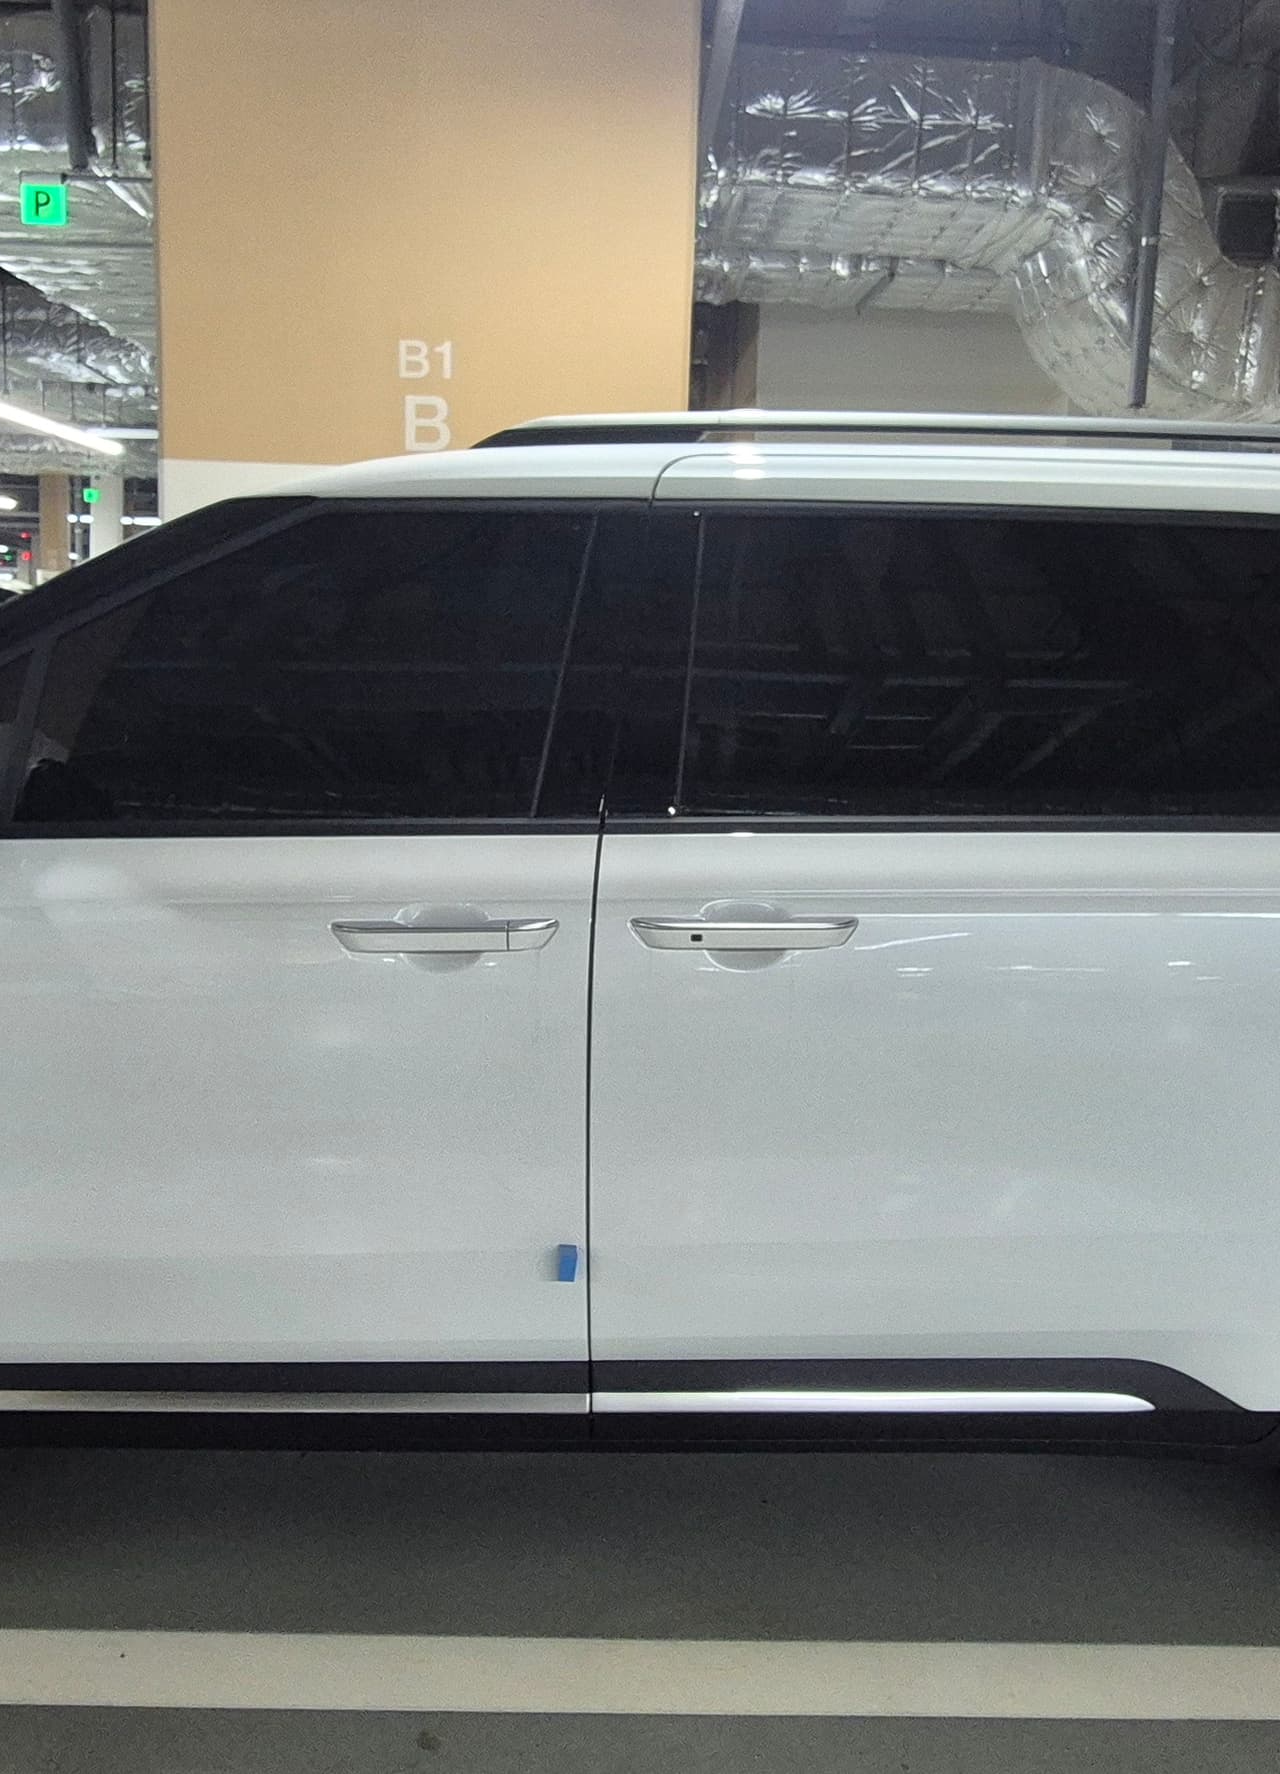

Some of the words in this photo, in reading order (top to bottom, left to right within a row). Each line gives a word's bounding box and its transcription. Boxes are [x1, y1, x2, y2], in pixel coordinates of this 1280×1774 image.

[35, 190, 51, 217] P
[399, 339, 452, 379] B1
[404, 395, 451, 452] B
